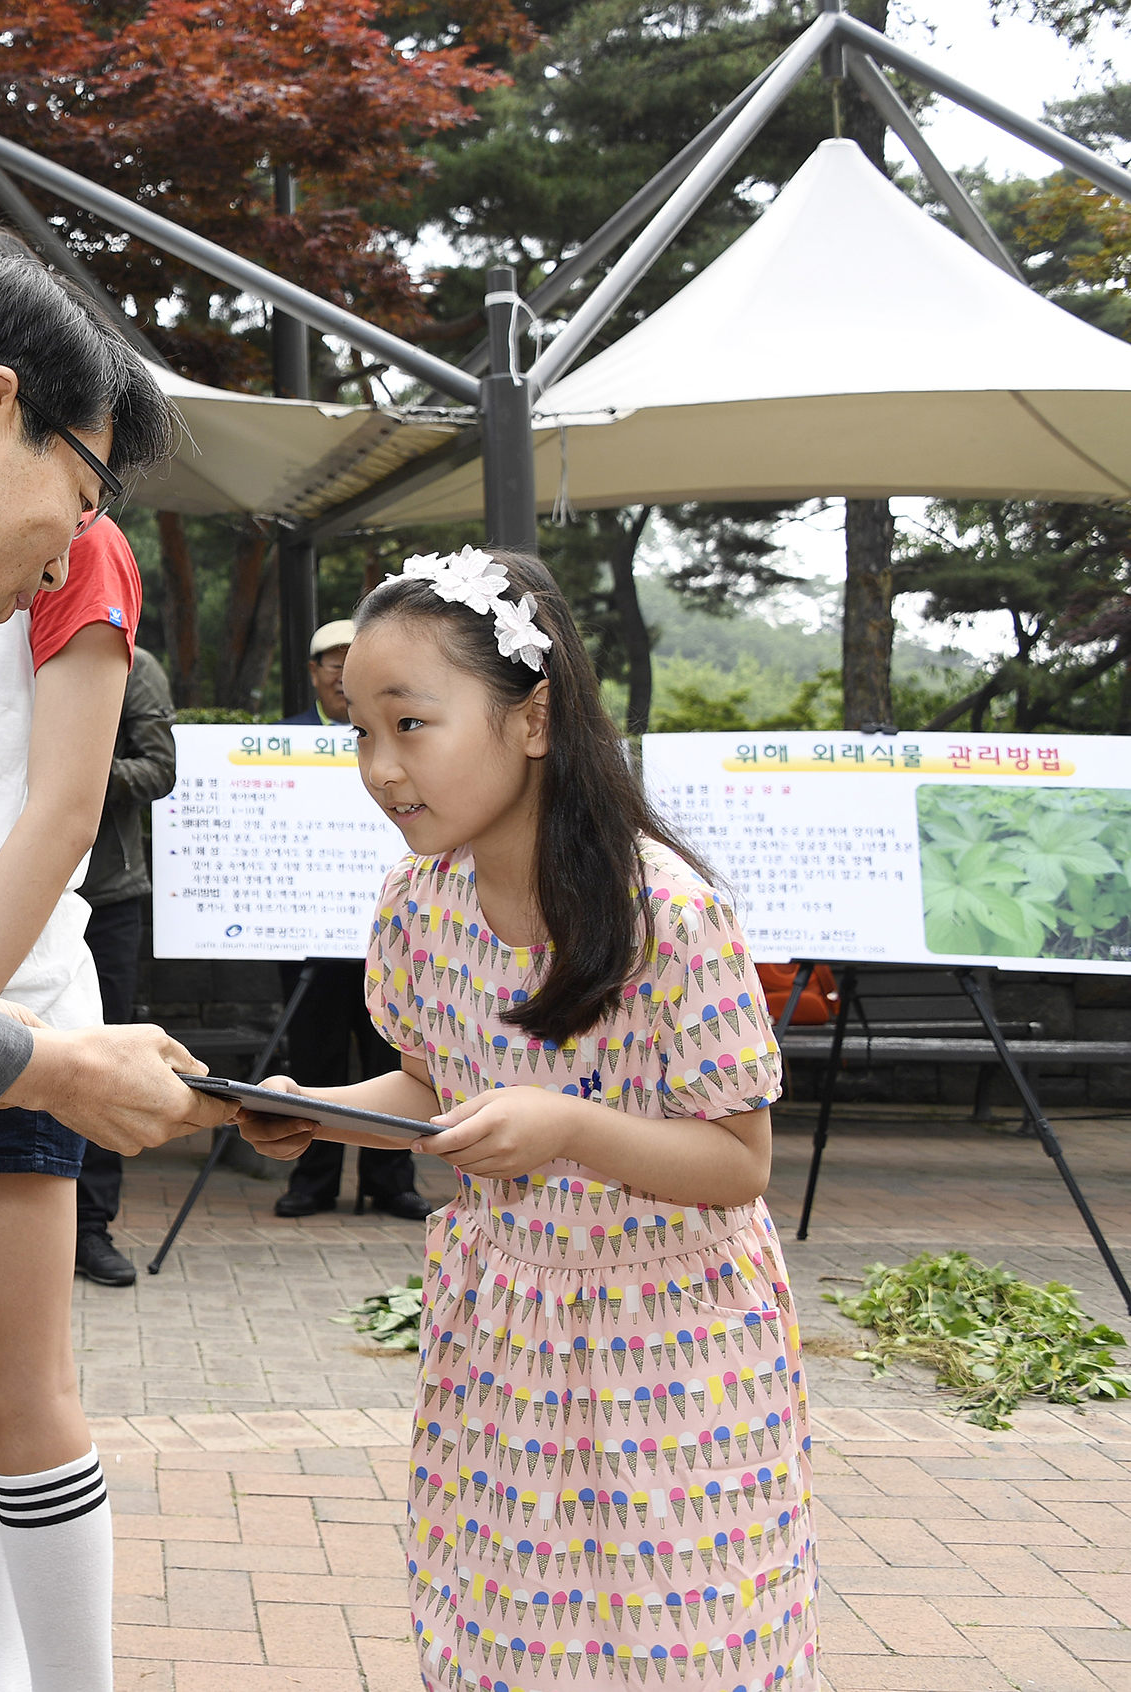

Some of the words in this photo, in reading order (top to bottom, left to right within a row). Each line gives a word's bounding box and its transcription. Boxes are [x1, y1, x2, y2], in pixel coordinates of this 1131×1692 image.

[240, 736, 290, 756] 위해
[736, 744, 788, 763] 위해
[812, 744, 923, 767] 외래식물
[948, 745, 1061, 771] 관리방법
